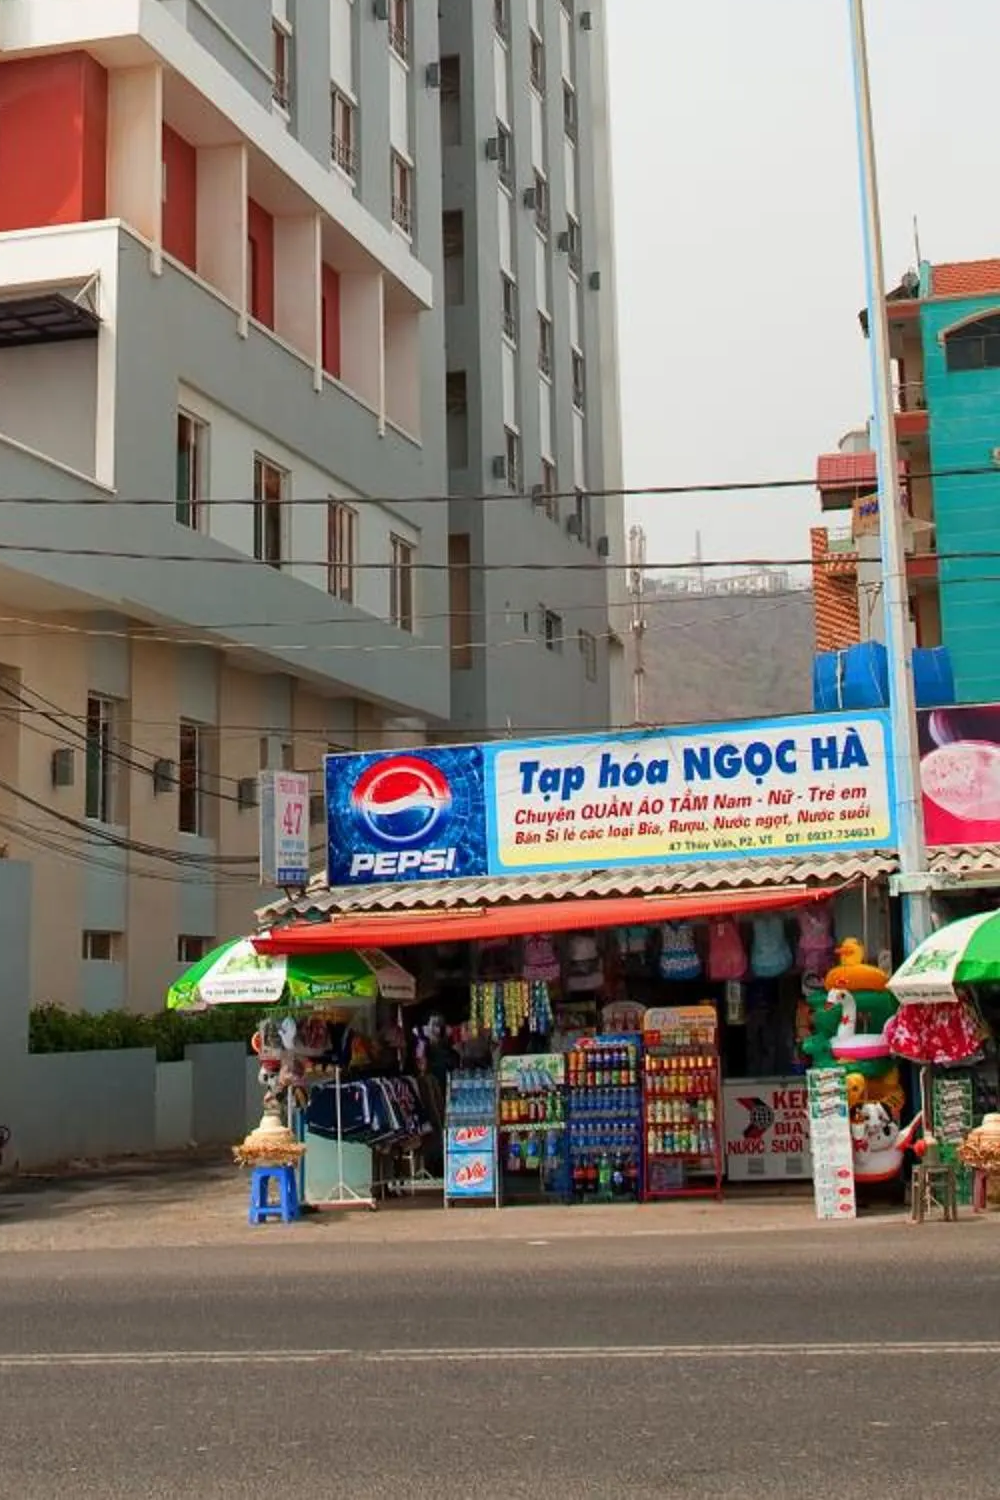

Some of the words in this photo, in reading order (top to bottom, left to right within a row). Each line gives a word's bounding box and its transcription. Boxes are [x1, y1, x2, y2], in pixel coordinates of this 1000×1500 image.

[520, 761, 584, 801] Tạp
[599, 753, 668, 788] hóa
[684, 739, 796, 784] NGỌC
[811, 727, 868, 770] HÀ
[283, 803, 302, 835] 47
[515, 808, 574, 826] Chuyên
[638, 797, 663, 815] ÁO
[714, 793, 751, 809] Nam
[768, 787, 793, 805] Nữ
[808, 781, 835, 801] Trẻ
[840, 787, 866, 799] em
[579, 829, 603, 840] các
[608, 823, 634, 841] loại
[714, 814, 749, 830] Nước
[797, 807, 835, 824] Nước
[839, 802, 870, 821] suối
[350, 848, 456, 876] PEPSI
